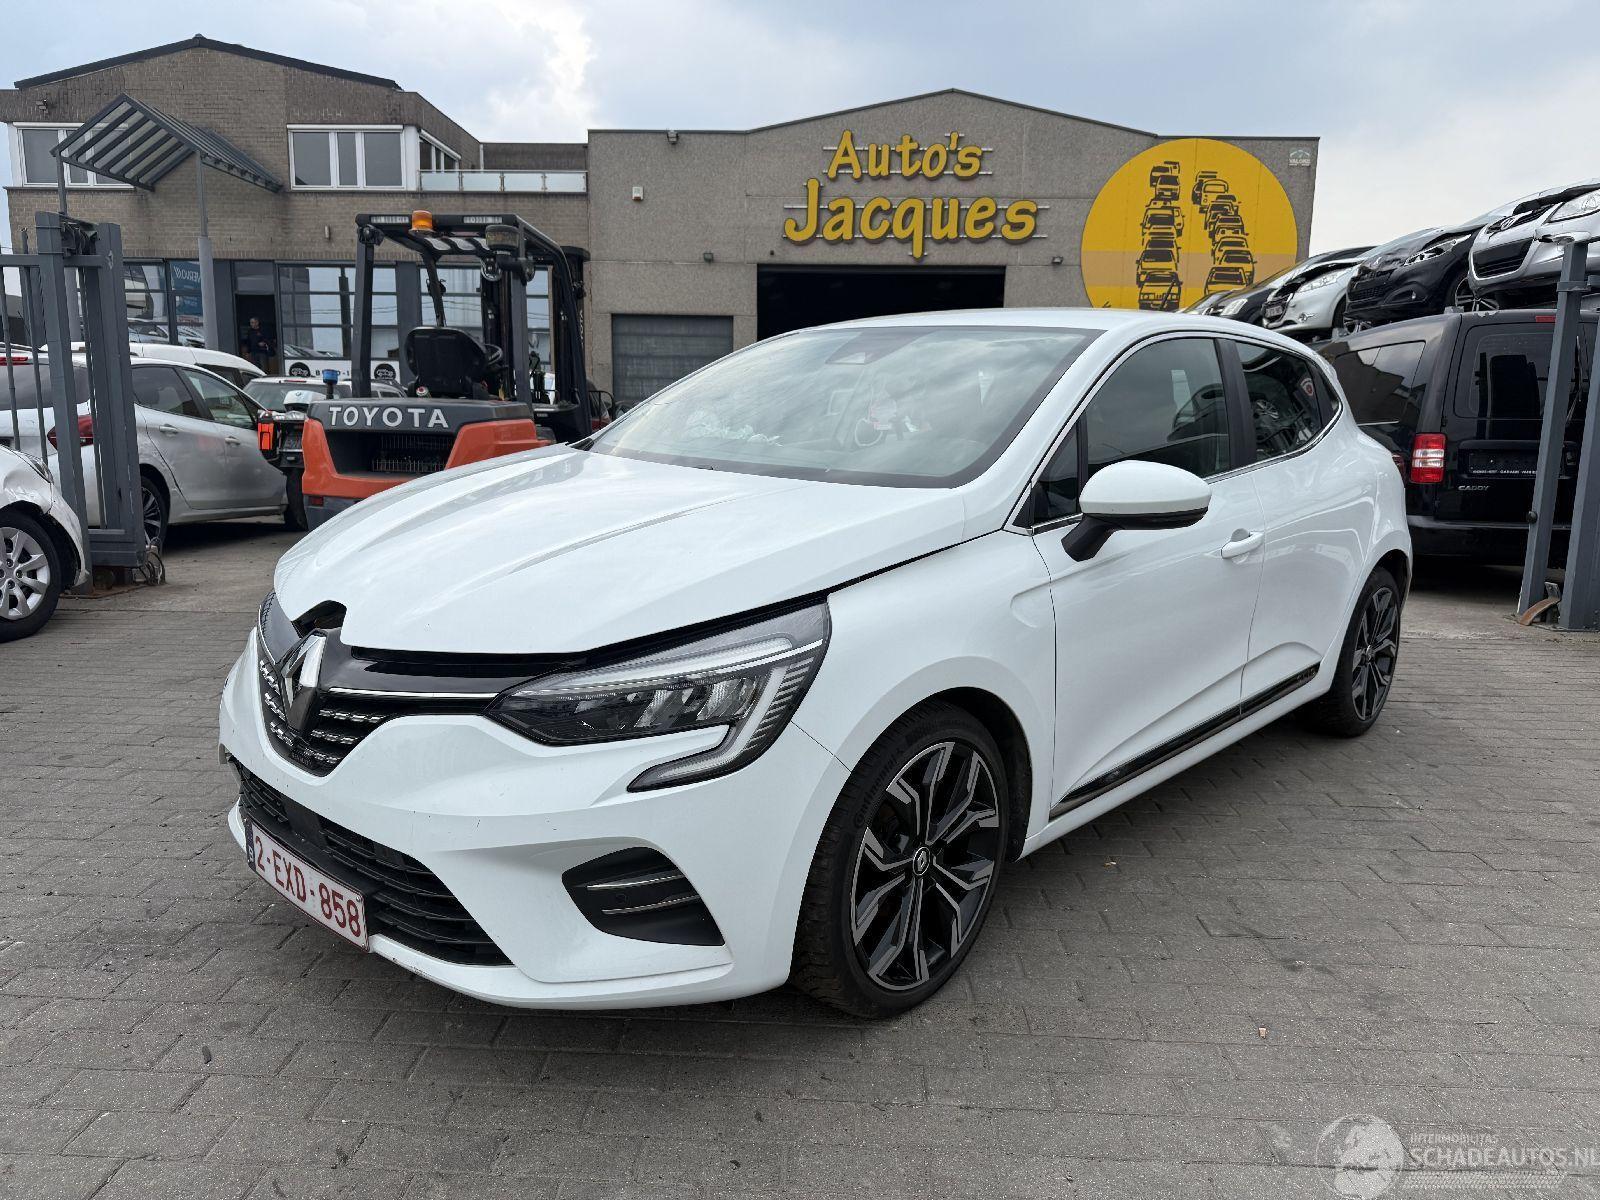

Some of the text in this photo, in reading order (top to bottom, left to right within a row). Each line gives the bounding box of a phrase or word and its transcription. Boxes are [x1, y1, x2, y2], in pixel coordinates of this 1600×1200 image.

[827, 129, 984, 180] Auto's
[784, 178, 1039, 260] Jacques
[329, 406, 449, 428] TOYOTA
[255, 835, 362, 938] 2-EXD-858
